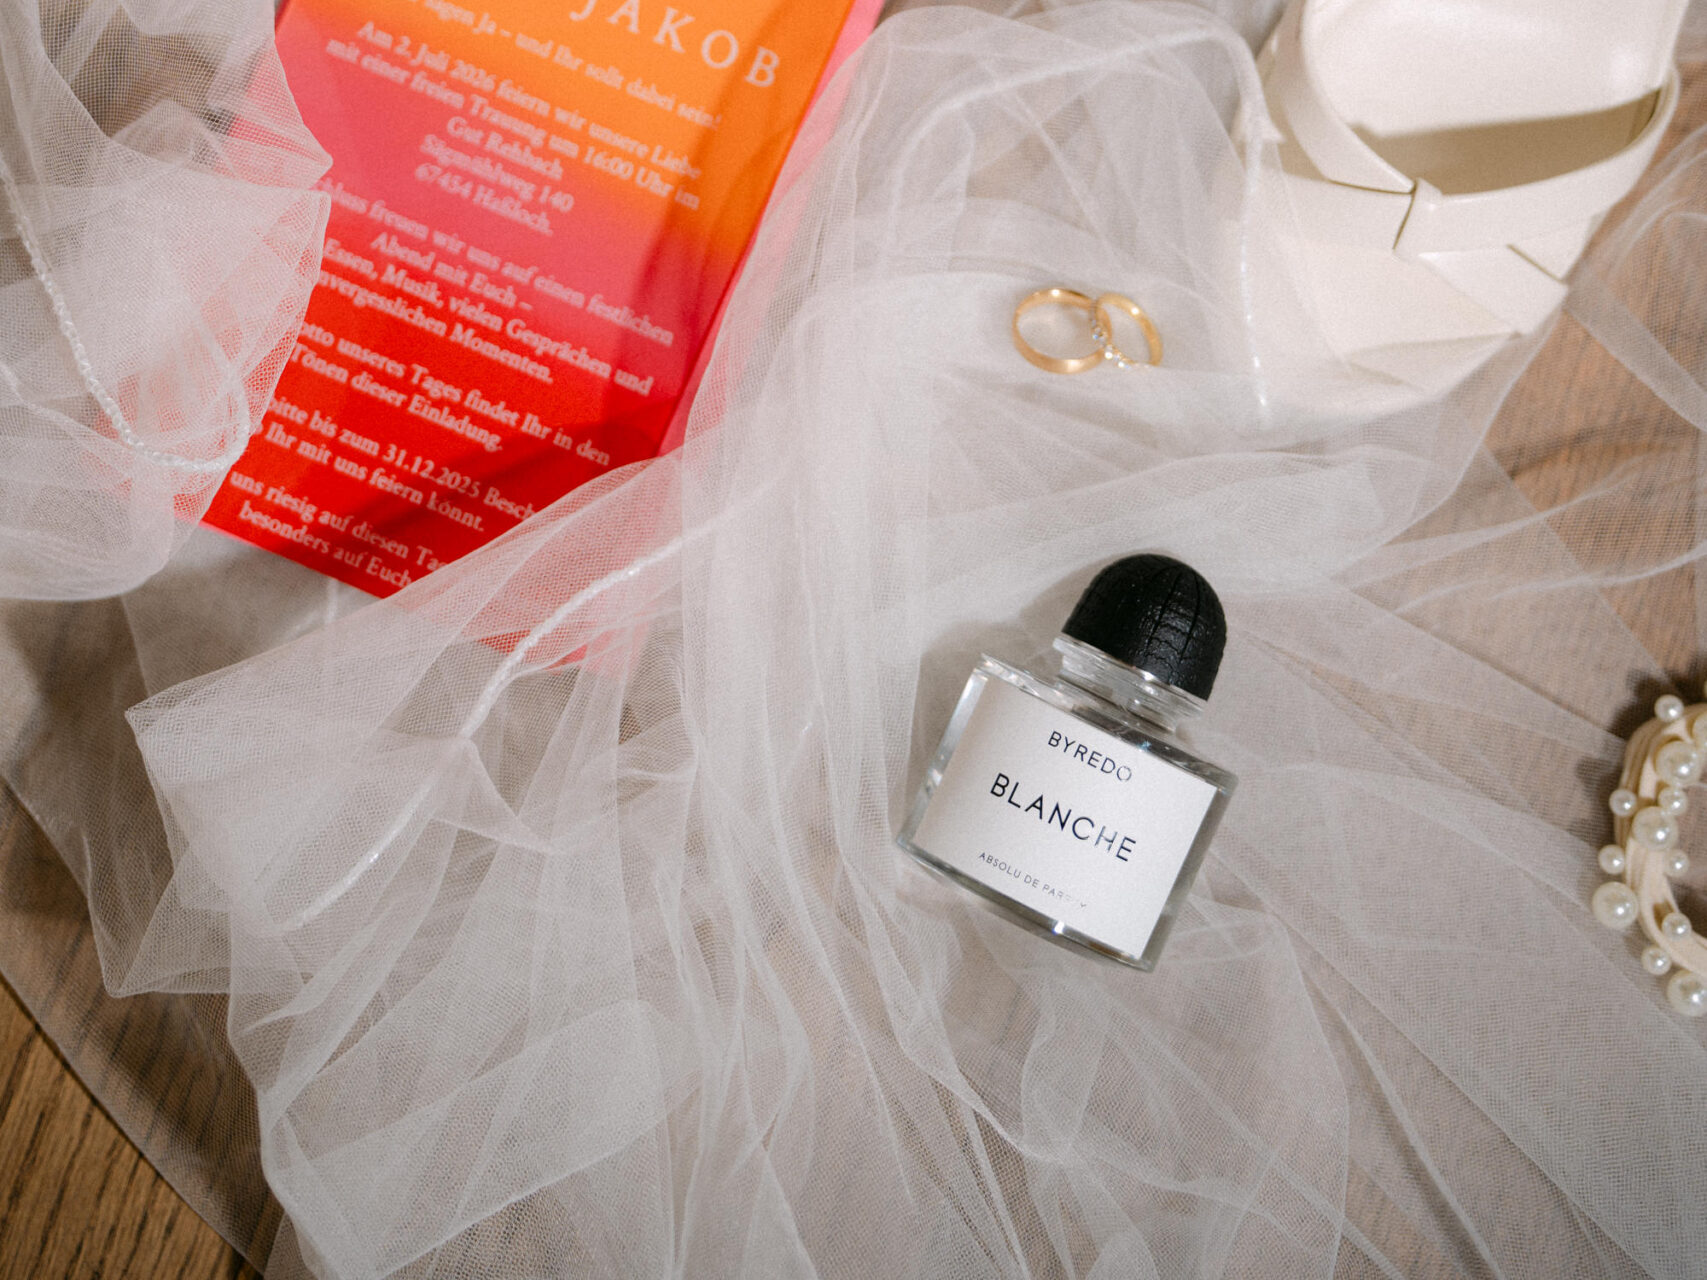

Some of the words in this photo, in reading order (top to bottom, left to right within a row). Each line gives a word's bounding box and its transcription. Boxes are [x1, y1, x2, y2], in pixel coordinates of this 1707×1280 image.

[356, 21, 392, 49] Am
[409, 43, 450, 72] Juli
[449, 59, 496, 91] 2026
[495, 79, 550, 116] feiern
[554, 107, 586, 130] wir
[588, 122, 649, 158] unsere
[650, 144, 701, 179] Liebe
[472, 12, 496, 35] Ja
[515, 32, 553, 58] und
[552, 44, 583, 70] Ihr
[584, 63, 624, 89] sollt
[625, 77, 675, 111] dabei
[325, 39, 360, 63] mit
[360, 54, 410, 83] einer
[410, 70, 464, 108] freien
[470, 93, 547, 147] Trauung
[548, 134, 579, 158] um
[635, 166, 673, 197] Uhr
[674, 188, 699, 210] im
[446, 116, 484, 145] Gut
[484, 131, 563, 180] Rehbach
[538, 185, 574, 212] 140
[368, 200, 428, 240] freuen
[432, 230, 465, 254] wir
[466, 245, 500, 270] uns
[501, 262, 538, 284] auf
[533, 275, 585, 308] einen
[586, 294, 673, 346] festlichen
[370, 232, 435, 271] Abend
[433, 261, 468, 286] mit
[468, 271, 516, 308] Euch
[314, 270, 447, 336] nvergesslichen
[449, 322, 553, 383] Momenten.
[318, 238, 377, 280] Essen,
[380, 263, 443, 308] Musik,
[449, 296, 502, 331] vielen
[505, 318, 611, 379] Gesprächen
[614, 369, 653, 395] und
[297, 321, 334, 346] otto
[336, 338, 405, 377] unseres
[411, 363, 462, 402] Tages
[463, 389, 519, 426] findet
[520, 412, 551, 438] Ihr
[552, 427, 572, 449] in
[576, 439, 609, 465] den
[350, 371, 407, 406] dieser
[407, 394, 505, 451] Einladung.
[264, 421, 297, 448] Ihr
[296, 440, 331, 464] mit
[333, 456, 367, 480] uns
[368, 467, 422, 504] feiern
[308, 409, 337, 437] bis
[338, 428, 379, 456] zum
[382, 443, 478, 496] 31.12.2025
[483, 486, 538, 523] Besch
[229, 471, 264, 495] uns
[265, 486, 317, 522] riesig
[318, 510, 349, 531] auf
[351, 521, 408, 558] diesen
[238, 499, 327, 552] besonders
[333, 548, 363, 567] auf
[1048, 731, 1132, 782] BYREDO
[990, 773, 1137, 862] BLANCHE
[979, 852, 1021, 878] ABSOLU
[1023, 874, 1040, 888] DE
